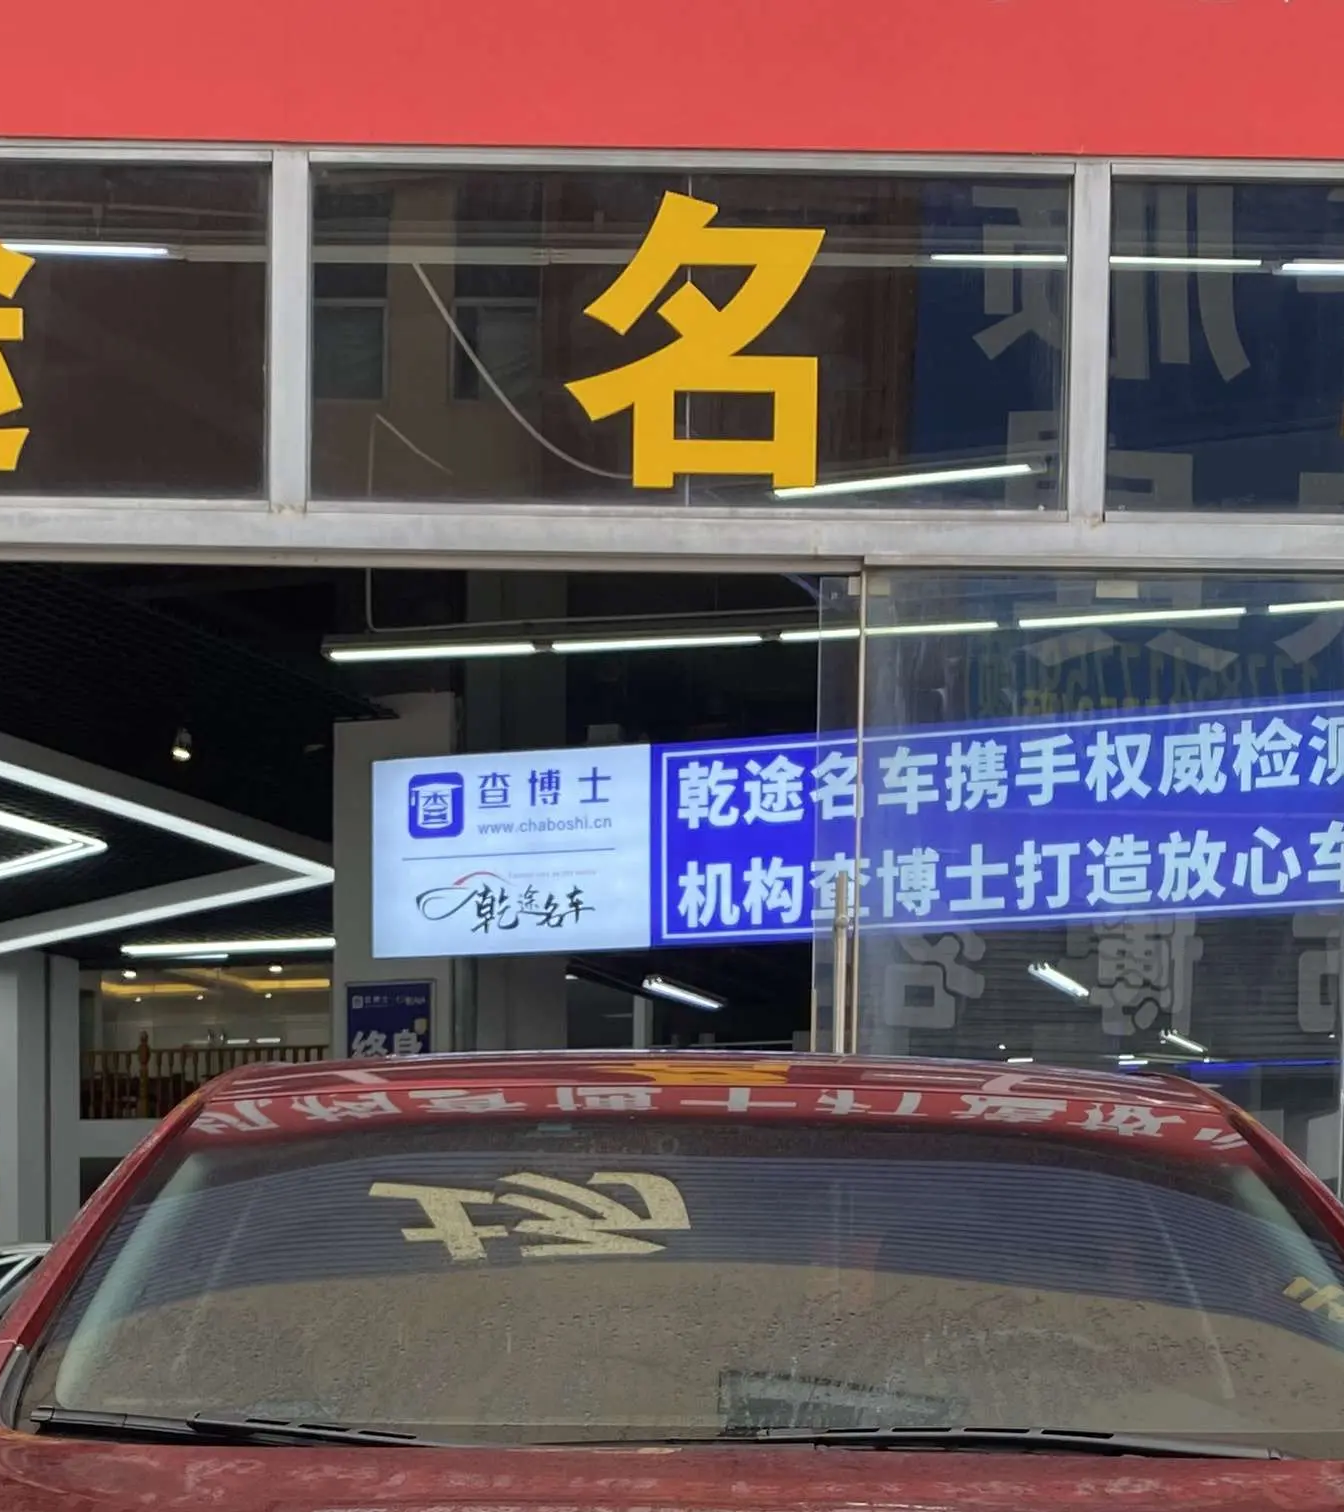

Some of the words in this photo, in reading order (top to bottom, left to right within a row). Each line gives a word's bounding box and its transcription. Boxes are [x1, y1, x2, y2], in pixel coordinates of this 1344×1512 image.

[478, 767, 612, 809] 查博士
[478, 815, 613, 835] www.chaboshi.cn
